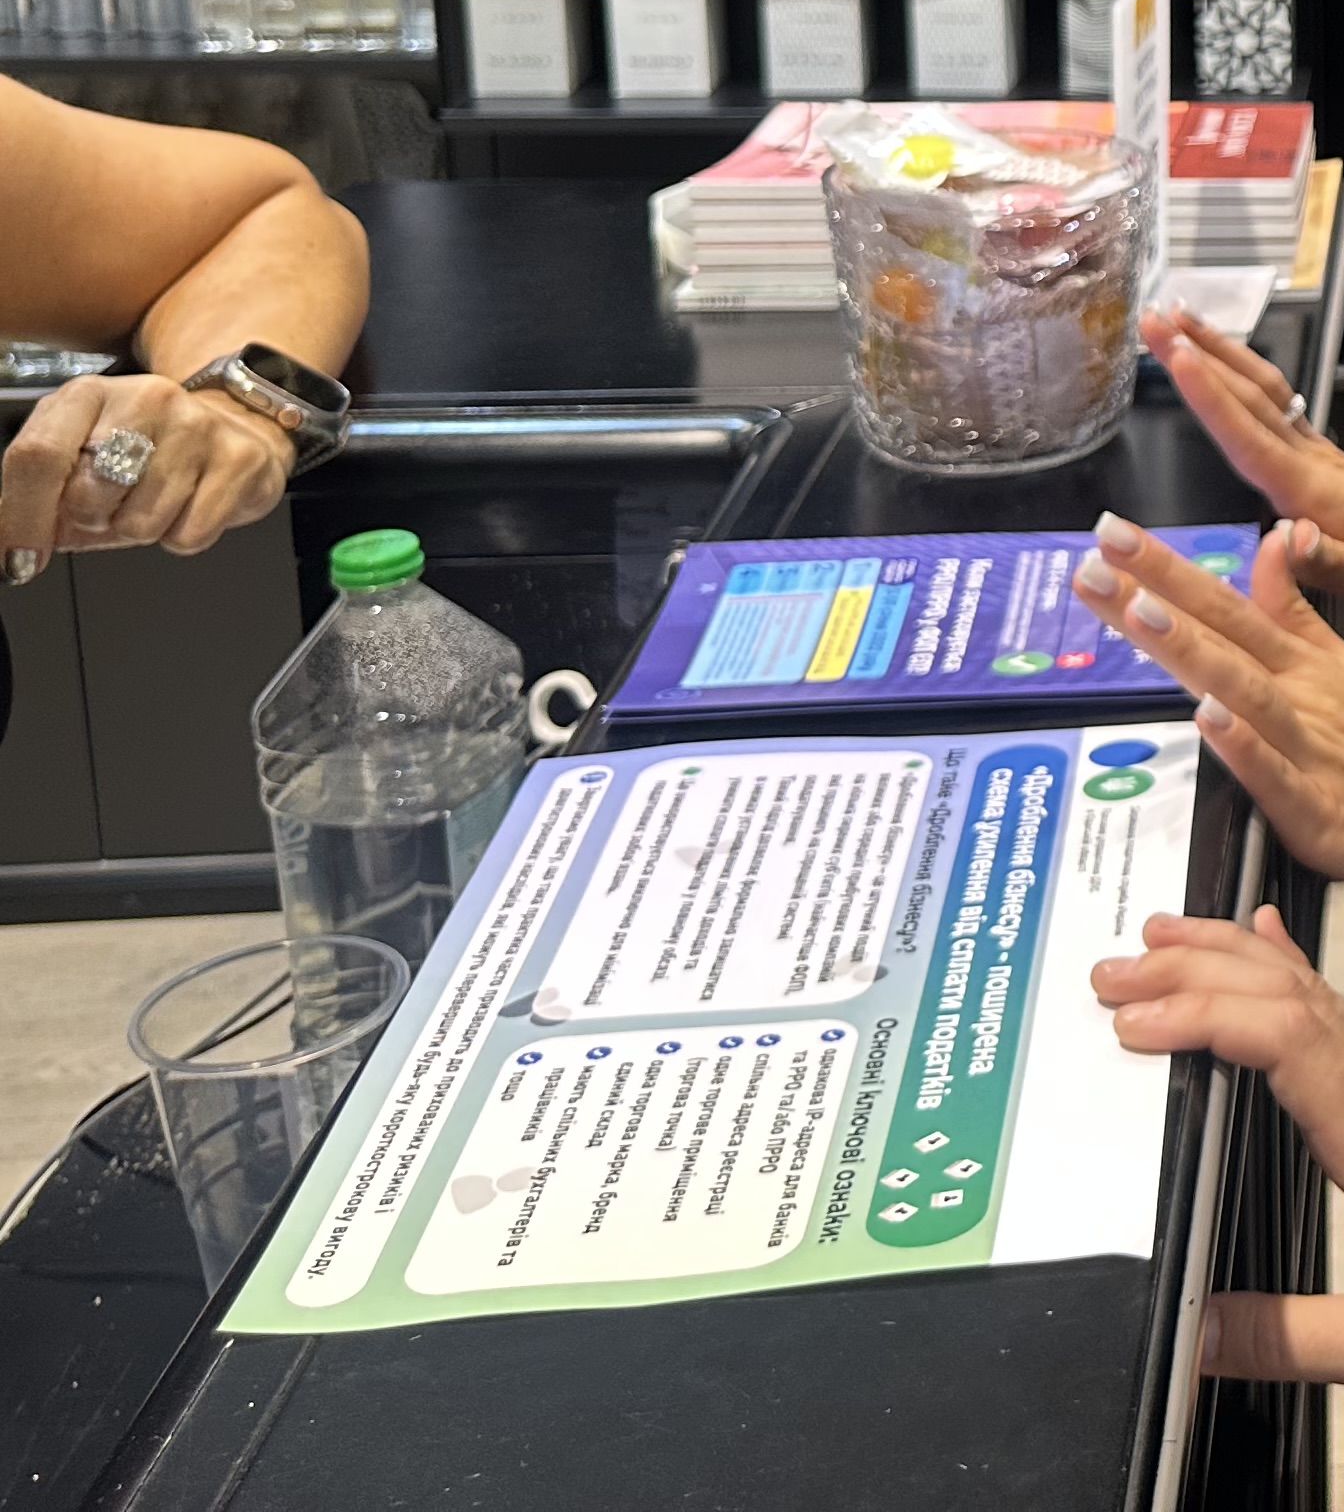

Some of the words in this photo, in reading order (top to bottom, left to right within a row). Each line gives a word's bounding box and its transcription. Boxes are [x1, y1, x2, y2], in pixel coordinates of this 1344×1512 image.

[941, 747, 969, 767] Що
[937, 771, 958, 798] таке
[982, 767, 1013, 818] схема
[1004, 764, 1057, 866] «Дроблення
[910, 801, 955, 880] «Дроблення
[956, 819, 1002, 903] ухилення
[890, 883, 933, 954] бізнесу»?
[948, 904, 991, 937] від
[987, 867, 1038, 950] бізнесу»
[939, 937, 977, 1010] сплати
[450, 988, 498, 1055] призводить
[962, 964, 1012, 1076] поширена
[441, 1056, 464, 1073] до
[637, 1059, 664, 1088] одна
[707, 1055, 731, 1085] одне
[743, 1052, 773, 1099] спільна
[791, 1049, 807, 1063] та
[805, 1047, 837, 1105] однакова
[860, 1017, 899, 1085] Основні
[909, 1012, 969, 1110] податків
[392, 1049, 442, 1106] будь-яку
[495, 1069, 526, 1102] тощо
[567, 1064, 595, 1104] мають
[600, 1060, 640, 1106] єдиний
[667, 1056, 705, 1108] (торгова
[783, 1065, 807, 1090] РРО
[401, 1074, 455, 1151] прихованих
[515, 1066, 570, 1142] працівників
[583, 1109, 615, 1148] склад
[616, 1091, 652, 1141] торгова
[689, 1087, 720, 1136] торгове
[723, 1101, 753, 1147] адреса
[769, 1093, 799, 1134] та/або
[839, 1089, 880, 1164] ключові
[540, 1106, 582, 1163] спільних
[651, 1110, 686, 1152] точка)
[757, 1136, 786, 1174] ПРРО
[331, 1108, 408, 1222] короткострокову
[373, 1152, 421, 1206] ризиків
[598, 1143, 632, 1188] марка,
[658, 1138, 707, 1223] приміщення
[776, 1173, 801, 1199] для
[500, 1165, 557, 1248] бухгалтерів
[580, 1190, 618, 1234] бренд
[766, 1201, 797, 1248] банків
[817, 1169, 853, 1245] ознаки:
[302, 1225, 347, 1280] вигоду.
[496, 1250, 516, 1266] та
